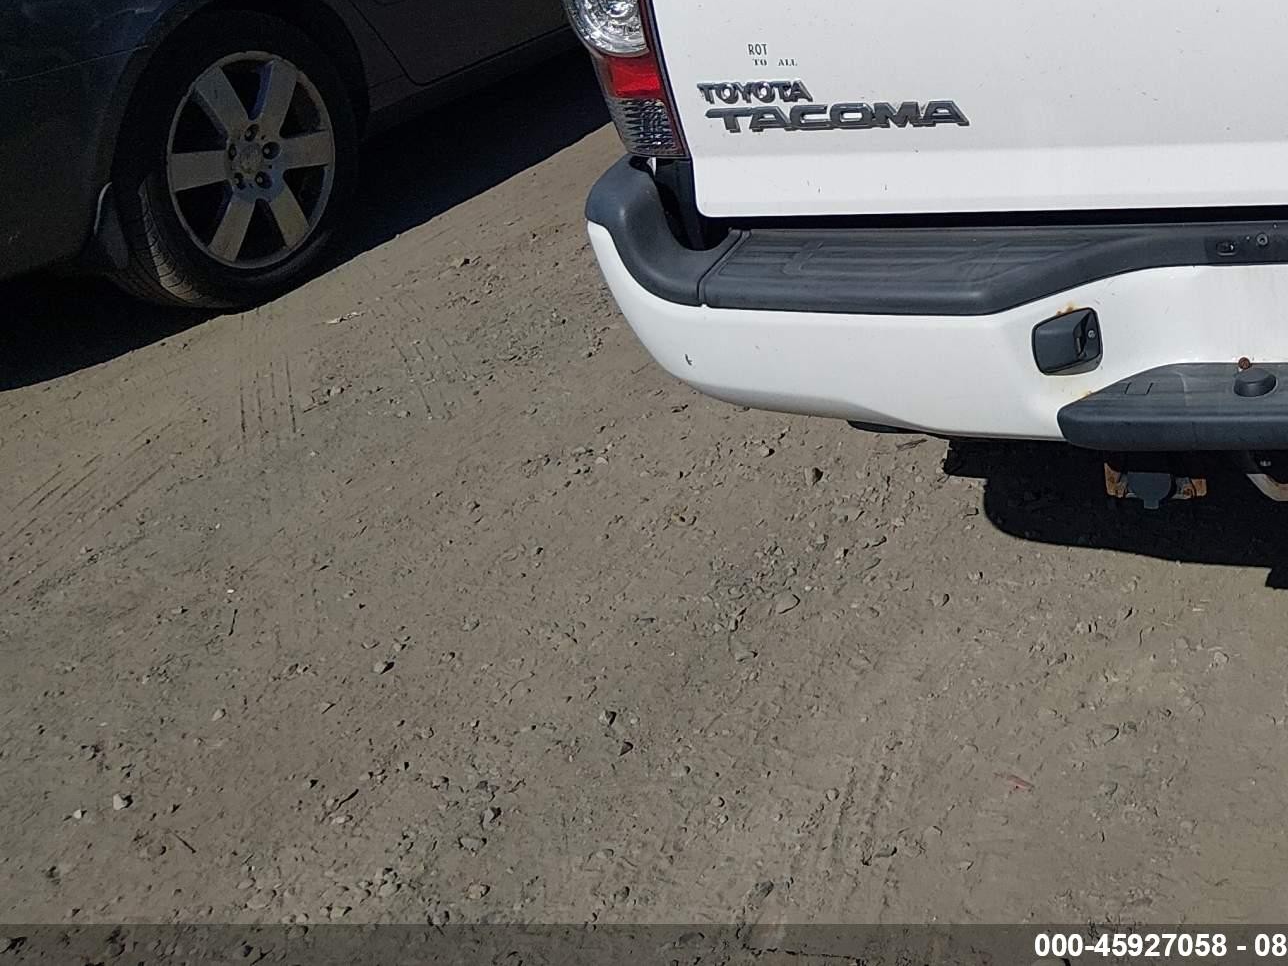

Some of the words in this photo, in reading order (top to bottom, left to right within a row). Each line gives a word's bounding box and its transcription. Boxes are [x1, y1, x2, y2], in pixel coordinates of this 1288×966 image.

[747, 43, 768, 56] ROT
[752, 59, 768, 67] TO
[778, 58, 798, 67] ALL
[696, 80, 814, 104] TOYOTA
[704, 100, 970, 133] TACOMA
